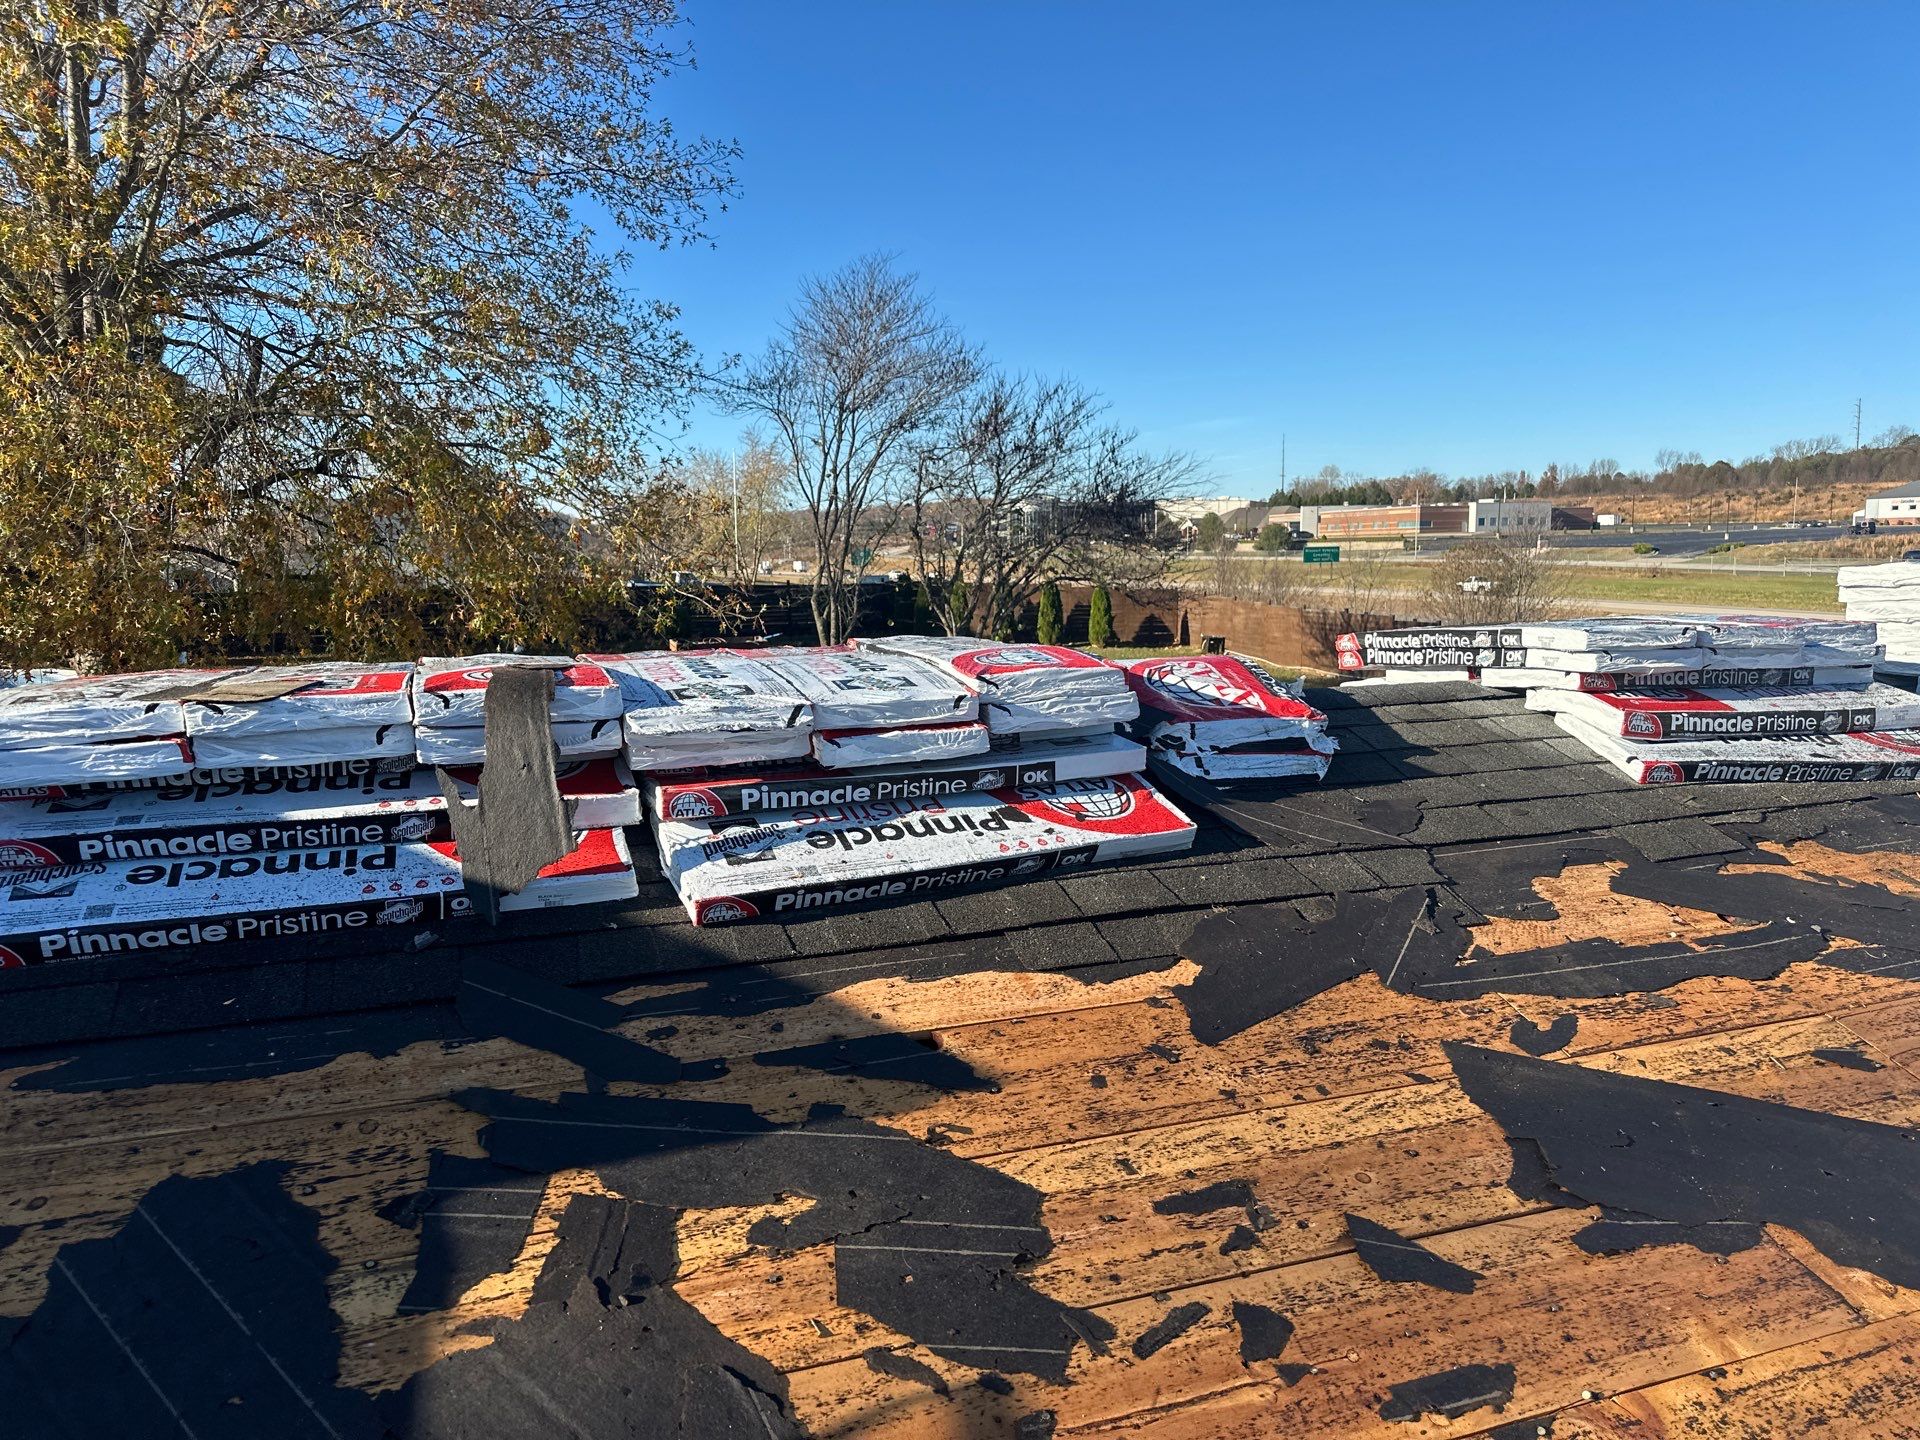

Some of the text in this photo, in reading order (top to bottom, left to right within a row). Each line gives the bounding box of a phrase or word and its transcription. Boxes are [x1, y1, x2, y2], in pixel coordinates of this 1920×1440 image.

[1422, 633, 1470, 648] Pristine
[1502, 635, 1519, 646] OK
[1425, 648, 1473, 665] Pristine
[1506, 650, 1523, 661] OK
[1703, 668, 1759, 686] Pristine
[1793, 669, 1810, 680] OK
[1757, 713, 1817, 732] Pristine
[1853, 714, 1871, 725] OK
[1630, 724, 1655, 733] ATLAS
[1023, 769, 1049, 784] OK
[1649, 772, 1677, 782] ATLAS
[1787, 763, 1853, 782] Pristine
[1893, 765, 1915, 778] OK
[0, 785, 48, 796] ATLAS
[877, 777, 967, 800] Pristine
[674, 806, 716, 818] ATLAS
[261, 823, 384, 848] Pristine
[391, 816, 436, 841] Scotchgard
[805, 809, 1011, 851] Pinnacle
[701, 823, 786, 860] Scotchgard
[1061, 851, 1089, 866] OK
[126, 846, 396, 888] Pinnacle
[913, 867, 1005, 891] Pristine
[451, 897, 472, 910] O
[237, 910, 368, 939] Pristine
[705, 911, 748, 923] ATLAS
